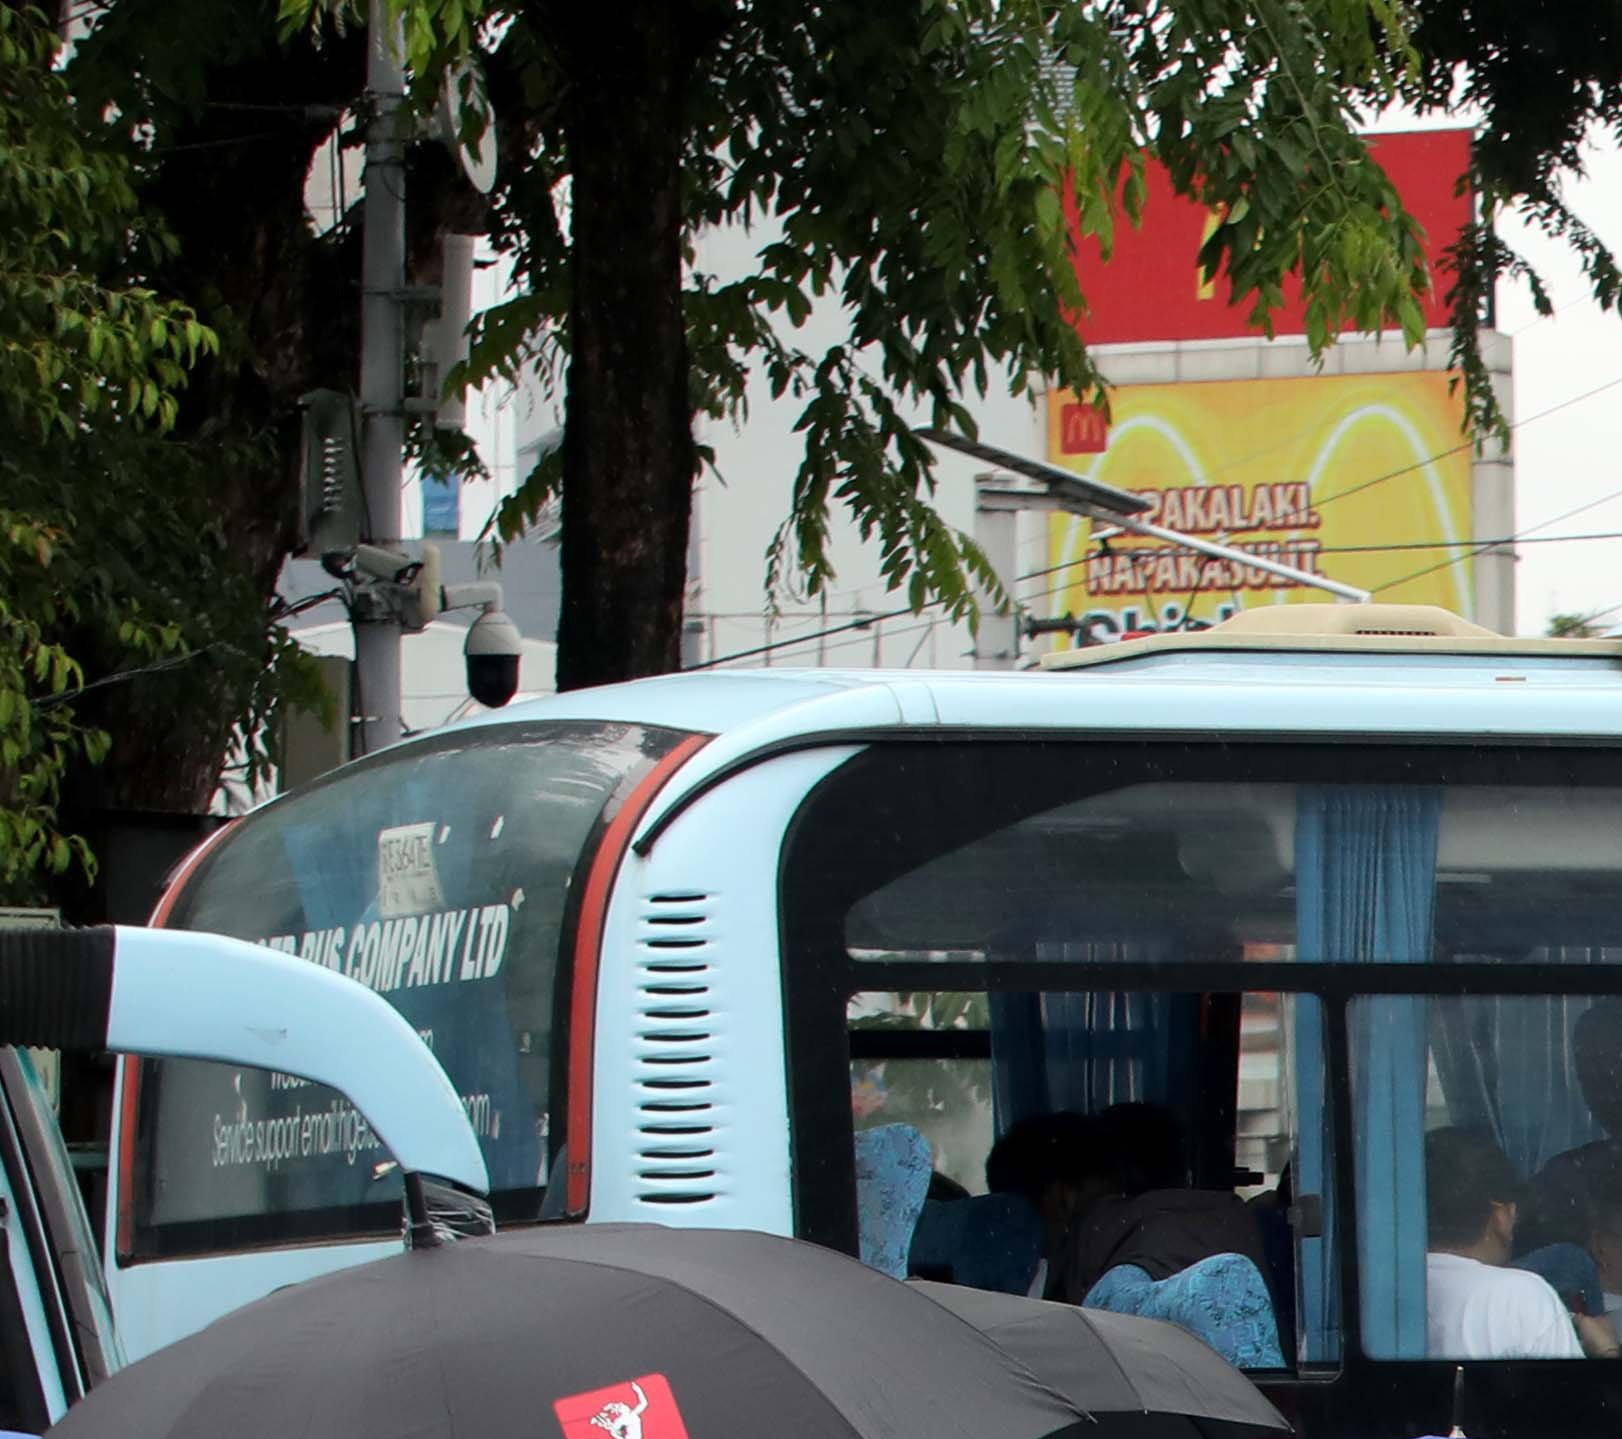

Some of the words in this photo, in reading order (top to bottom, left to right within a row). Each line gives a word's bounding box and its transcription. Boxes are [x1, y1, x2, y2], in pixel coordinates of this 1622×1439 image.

[1092, 482, 1322, 537] PAKALAKI.
[346, 910, 467, 993] COMPANY
[460, 904, 509, 981] LTD
